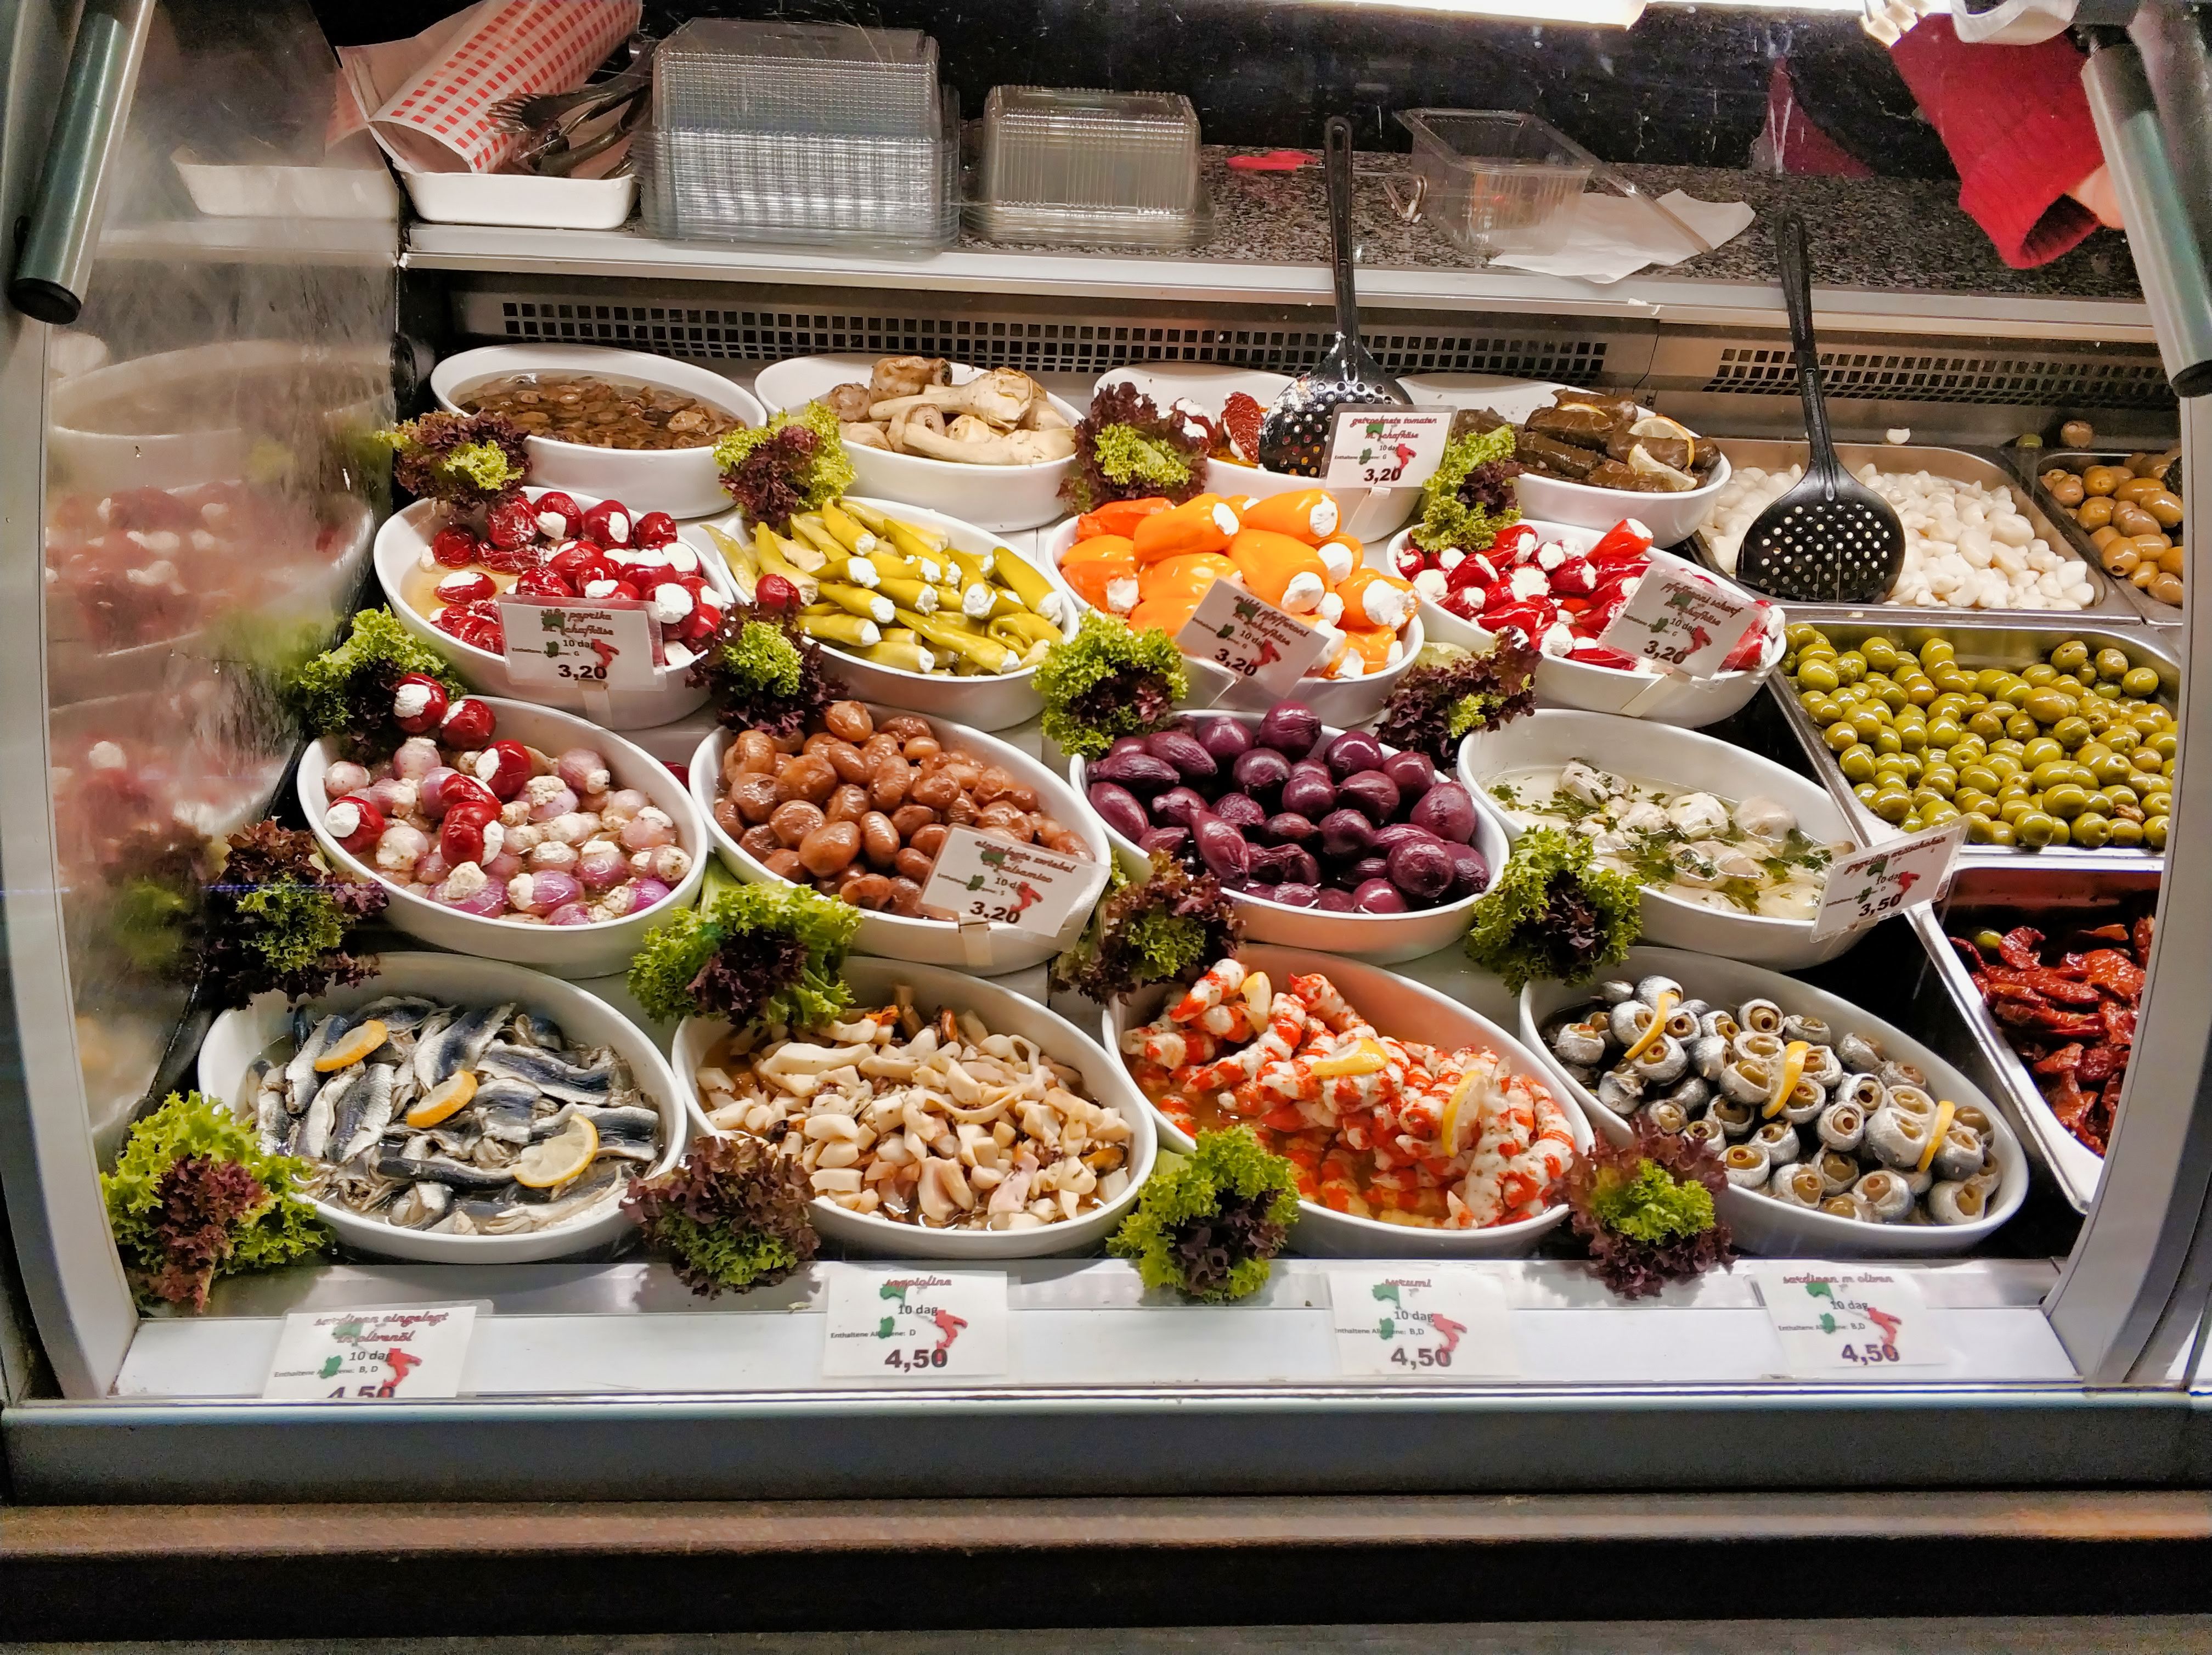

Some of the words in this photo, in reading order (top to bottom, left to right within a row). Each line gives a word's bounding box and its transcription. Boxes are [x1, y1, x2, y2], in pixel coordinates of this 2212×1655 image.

[1364, 468, 1402, 484] 3,20
[1710, 600, 1744, 618] scharf
[567, 611, 612, 622] paprika
[1669, 618, 1682, 627] 10
[562, 623, 614, 637] chafkäse
[1240, 630, 1251, 640] 10
[1644, 640, 1686, 664] 3,20
[1215, 648, 1259, 677] 3,20
[558, 665, 607, 680] 3,20
[995, 877, 1008, 886] 10
[1876, 876, 1886, 885] 10
[1859, 893, 1901, 916] 3,50
[1783, 1273, 1839, 1284] sardinen
[1858, 1273, 1894, 1284] oliven
[898, 1305, 912, 1314] 10
[916, 1304, 938, 1316] dag
[1831, 1301, 1845, 1310] 10
[1848, 1300, 1868, 1311] dag
[383, 1311, 449, 1327] eingelegt
[1394, 1311, 1408, 1320] 10
[1412, 1311, 1434, 1322] dag
[356, 1330, 416, 1342] olivenöl
[349, 1351, 366, 1361] 10
[885, 1349, 947, 1372] 4,50
[1391, 1348, 1452, 1370] 4,50
[1842, 1344, 1899, 1365] 4,50
